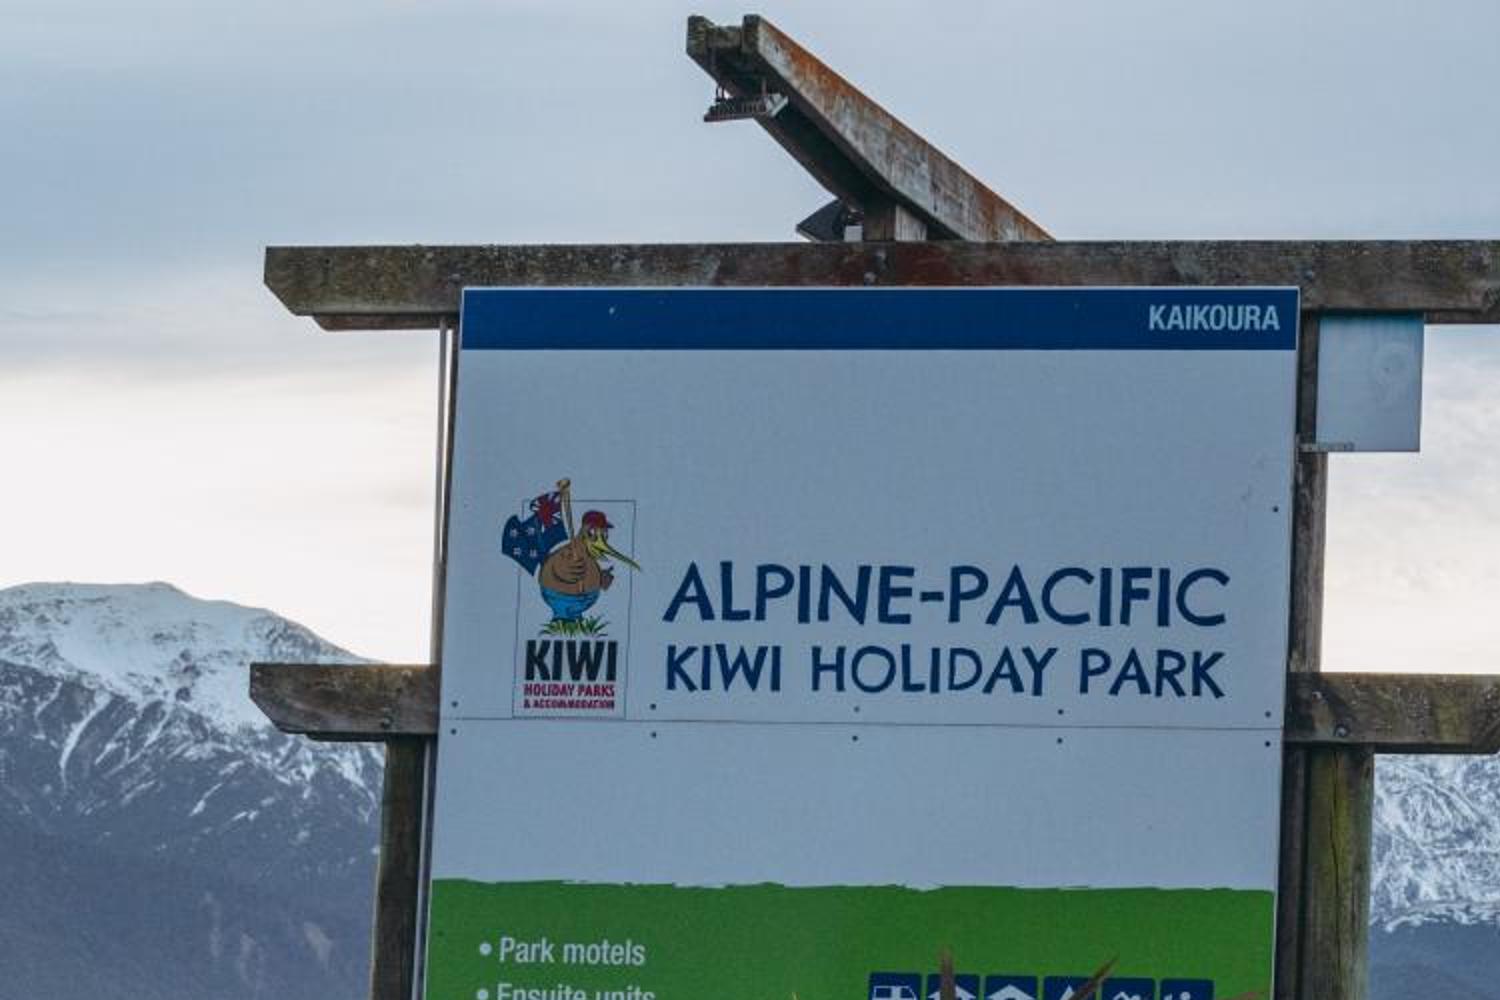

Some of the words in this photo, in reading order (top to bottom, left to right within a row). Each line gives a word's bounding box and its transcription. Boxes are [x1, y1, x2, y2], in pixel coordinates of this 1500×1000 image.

[1149, 304, 1281, 331] KAIKOURA
[661, 560, 1231, 628] ALPINE-PACIFIC
[525, 639, 618, 682] KIWI
[665, 643, 782, 693] KIWI
[810, 643, 1059, 698] HOLIDAY
[1079, 647, 1227, 700] PARK
[523, 683, 575, 697] HOLIDAY
[577, 684, 616, 697] PARKS
[500, 936, 555, 963] Park
[562, 939, 647, 966] motels
